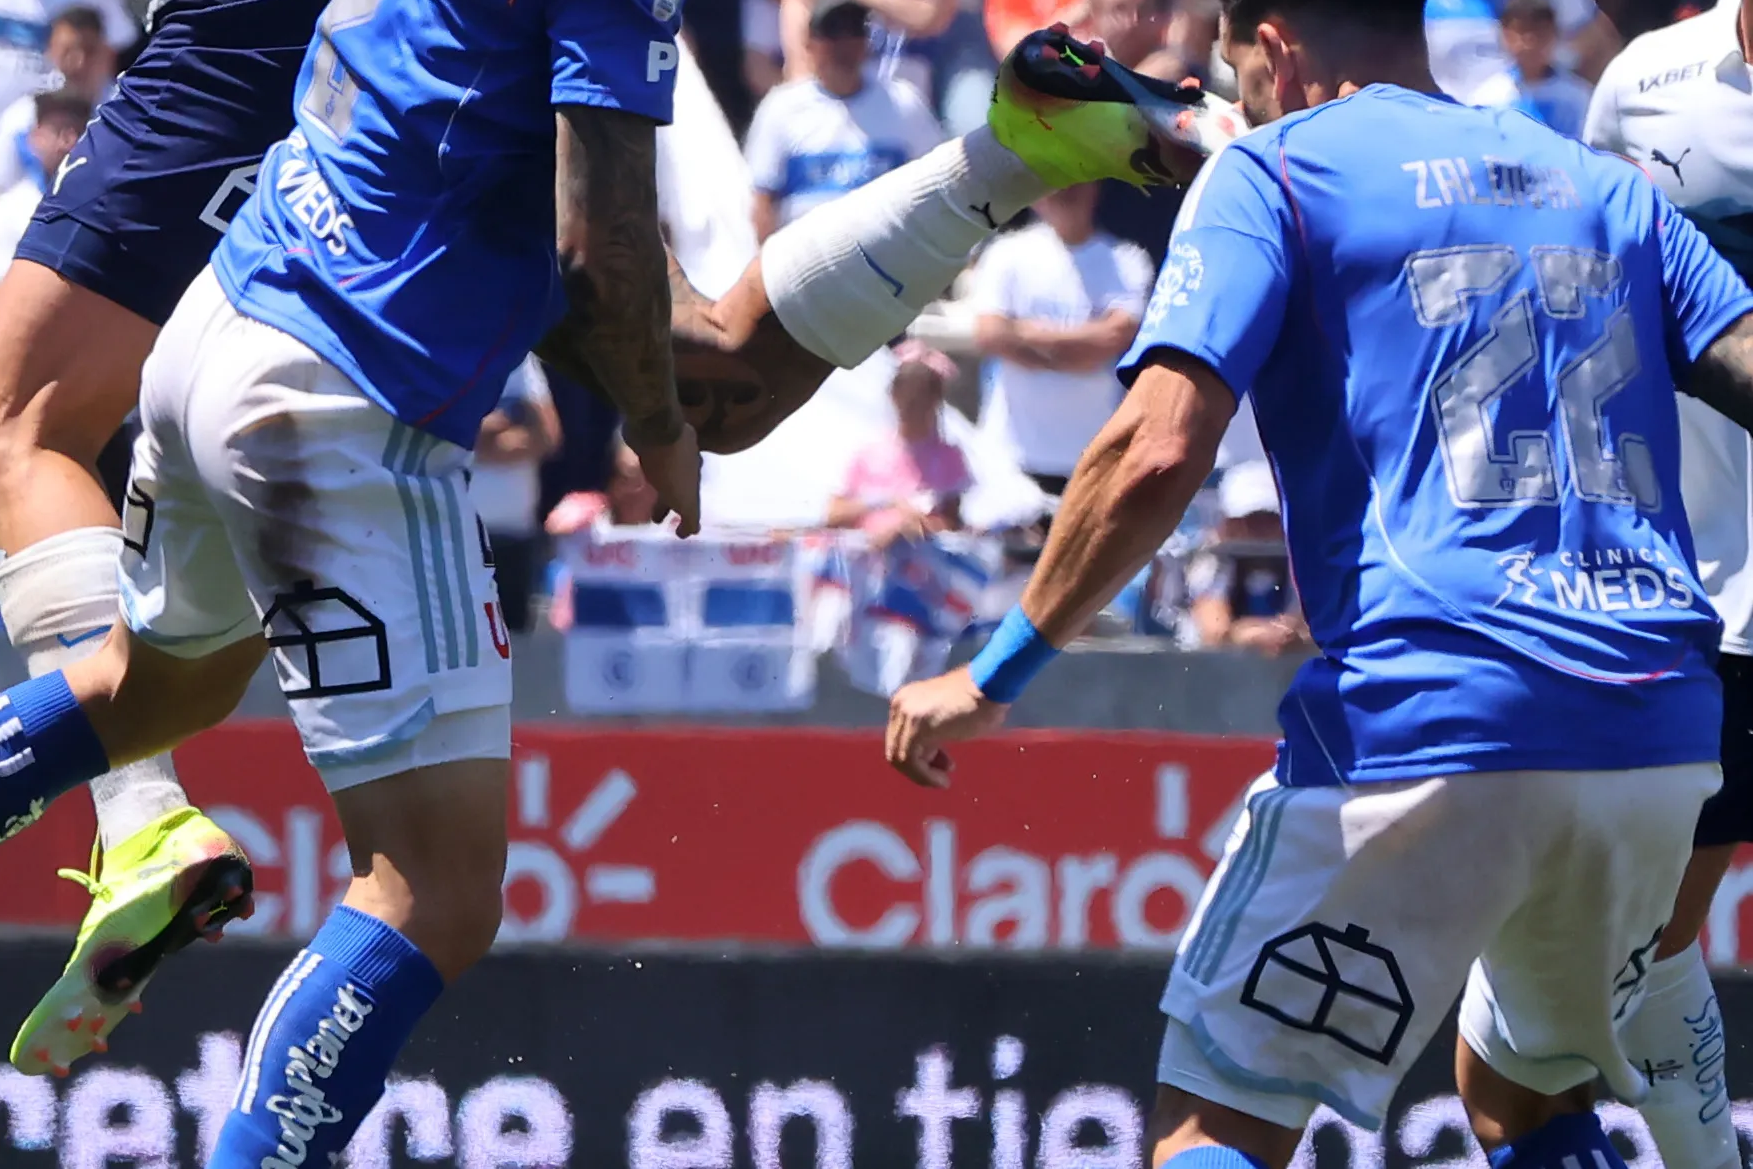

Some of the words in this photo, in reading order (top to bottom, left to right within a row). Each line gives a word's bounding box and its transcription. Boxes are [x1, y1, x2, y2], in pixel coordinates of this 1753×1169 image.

[276, 159, 355, 256] MEDS
[1405, 244, 1663, 512] 22
[1549, 567, 1694, 612] MEDS
[797, 818, 1207, 949] Claro
[626, 1076, 855, 1169] en
